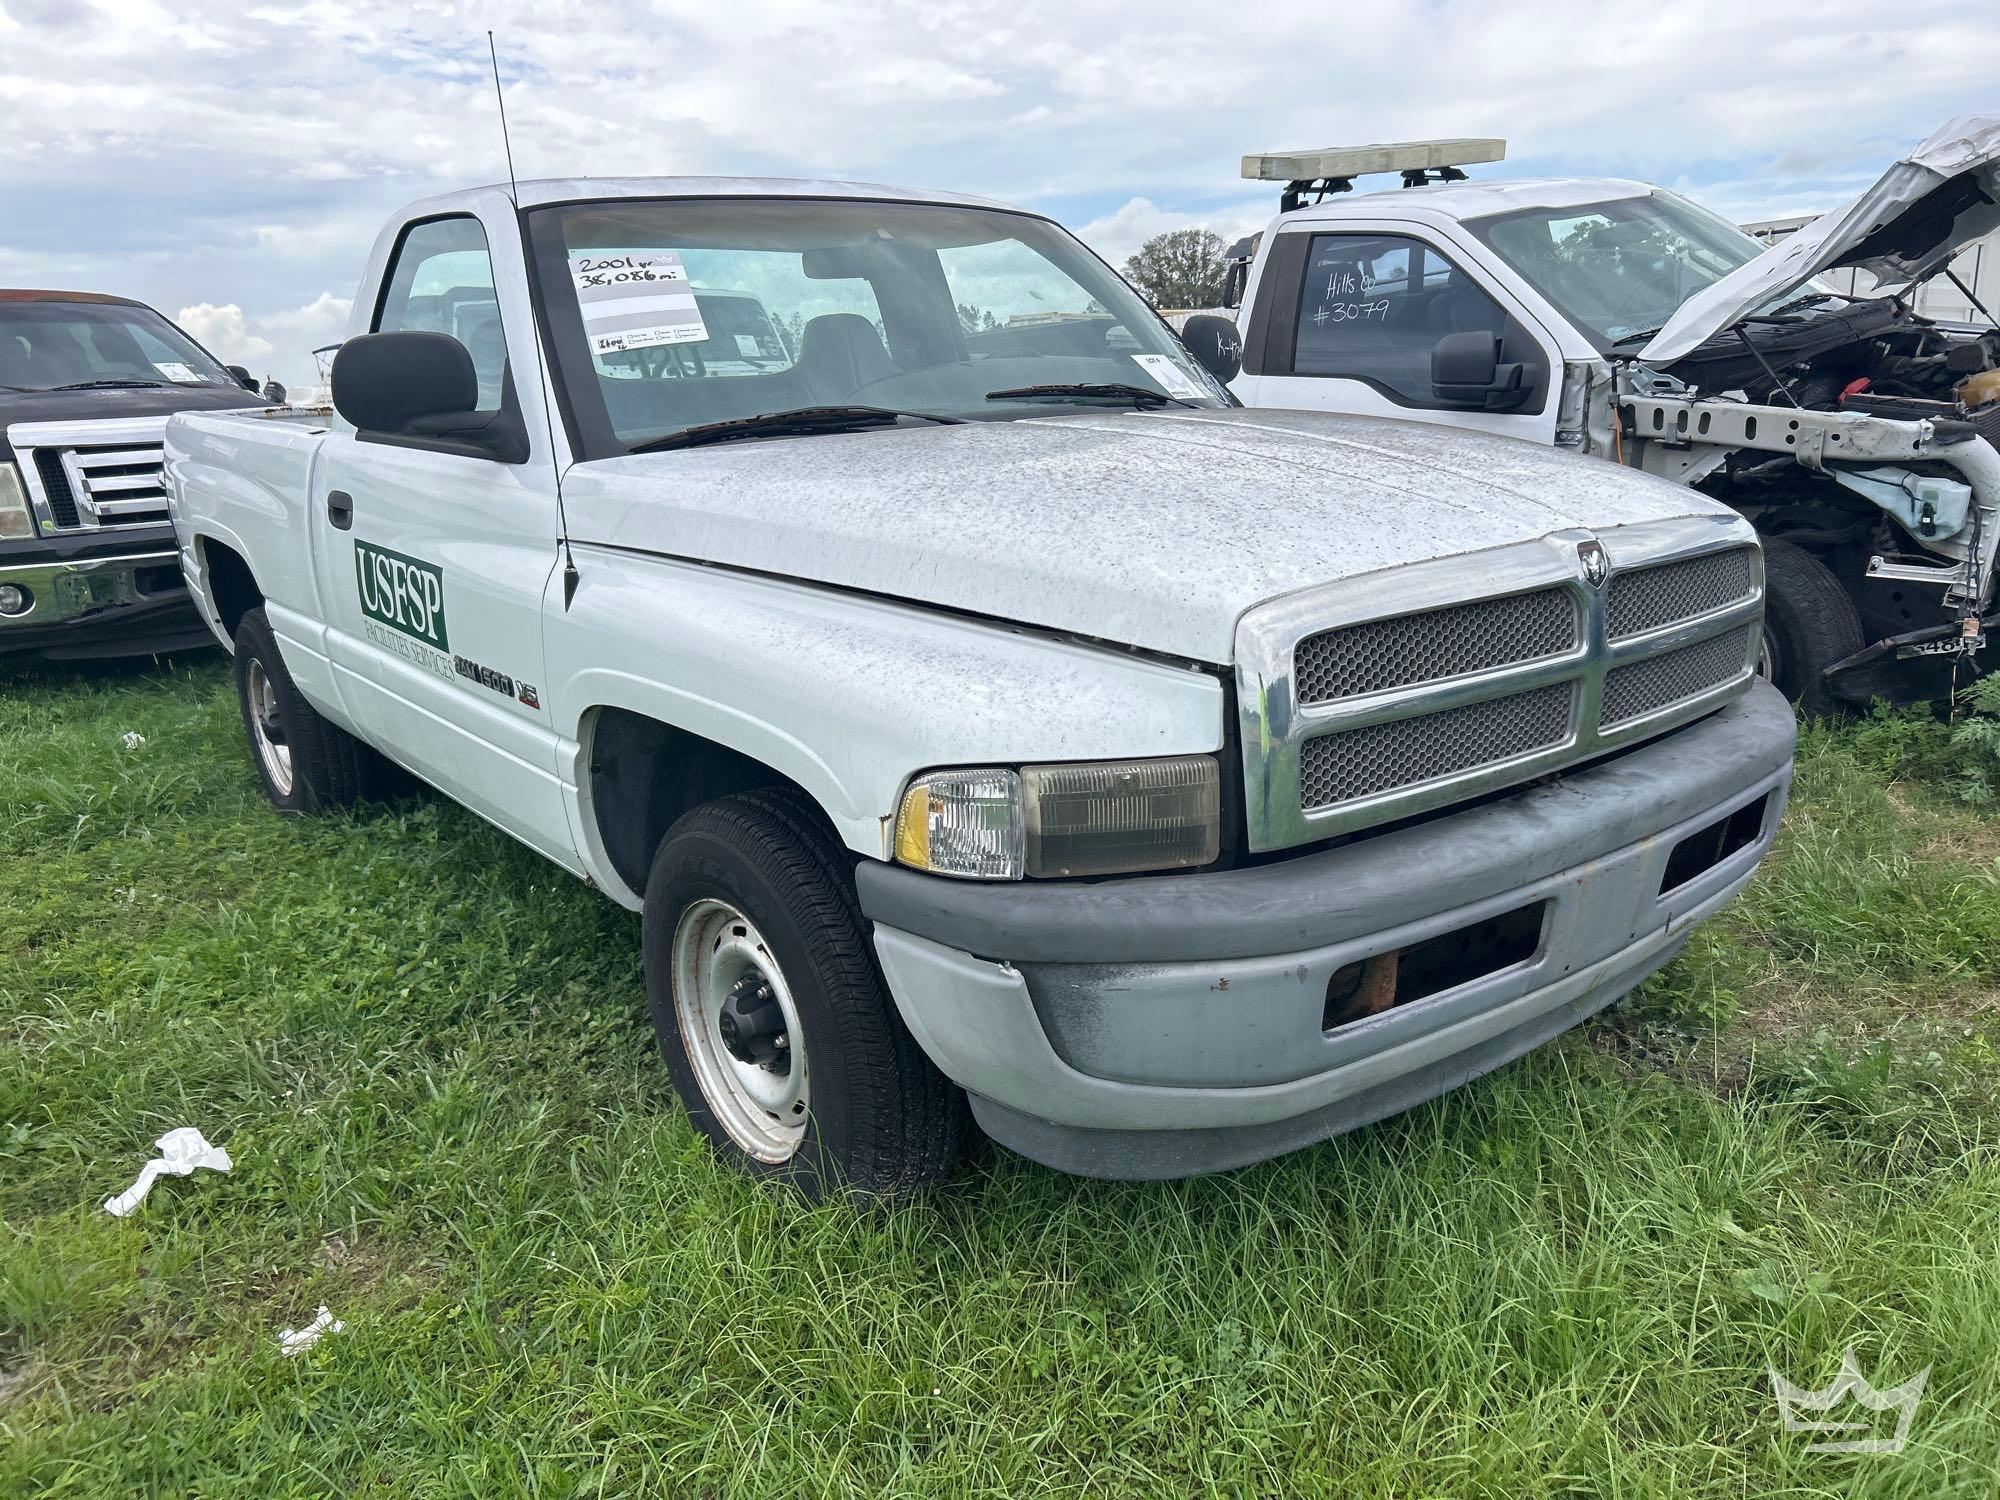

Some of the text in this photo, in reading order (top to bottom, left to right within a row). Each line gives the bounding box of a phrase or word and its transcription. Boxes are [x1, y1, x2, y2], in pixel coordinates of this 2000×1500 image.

[579, 257, 633, 273] 2001
[579, 270, 656, 289] 38,086
[1313, 299, 1390, 327] #3079
[357, 547, 440, 641] USFSP
[364, 620, 456, 682] FACILITIES SERVICES
[453, 655, 482, 684] RAM
